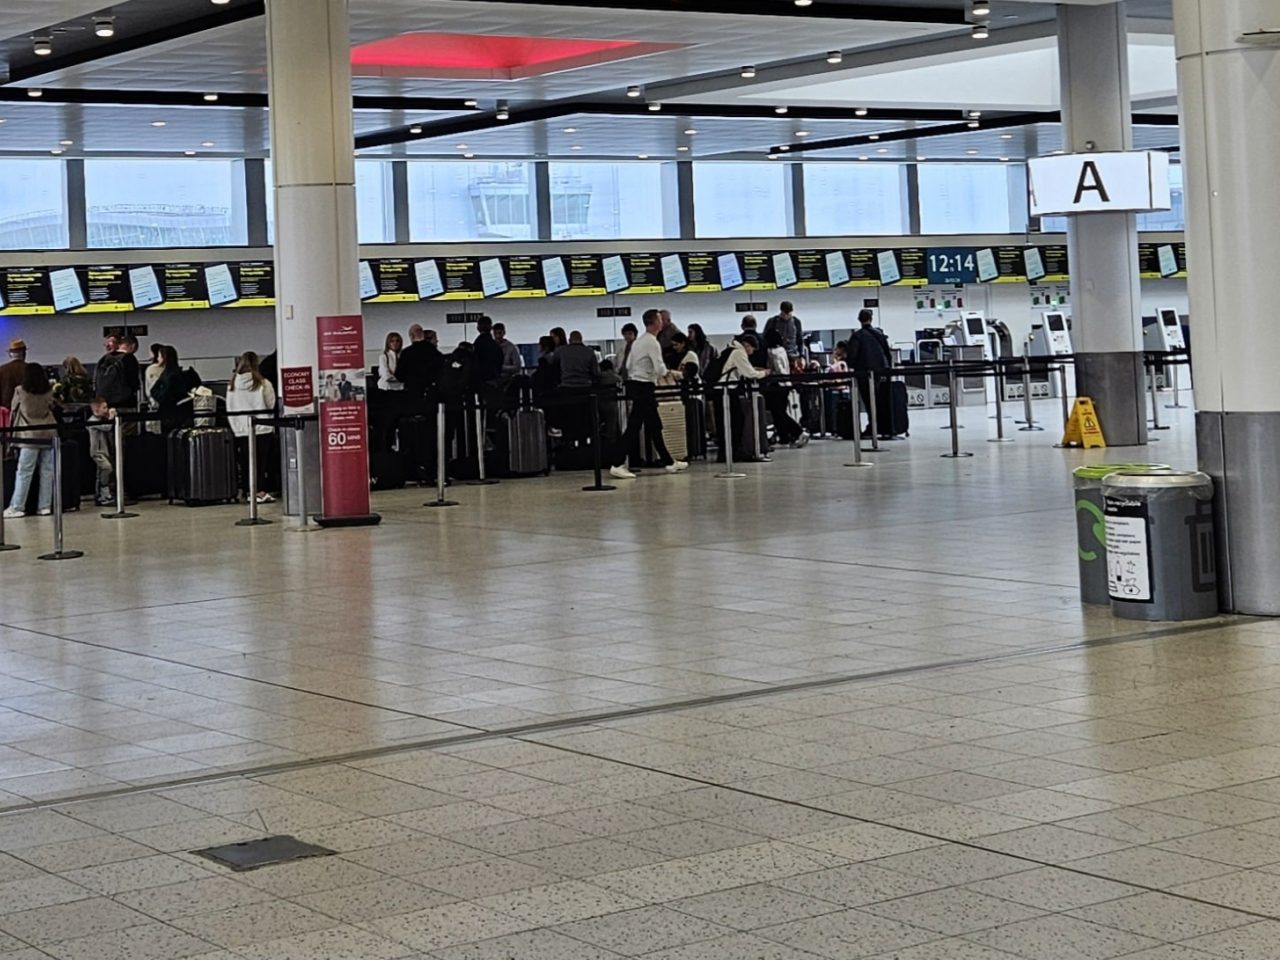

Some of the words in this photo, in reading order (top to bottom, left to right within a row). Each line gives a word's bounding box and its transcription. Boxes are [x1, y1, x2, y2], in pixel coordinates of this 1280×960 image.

[1073, 160, 1111, 204] A
[930, 254, 975, 272] 12:14
[328, 432, 346, 445] 60
